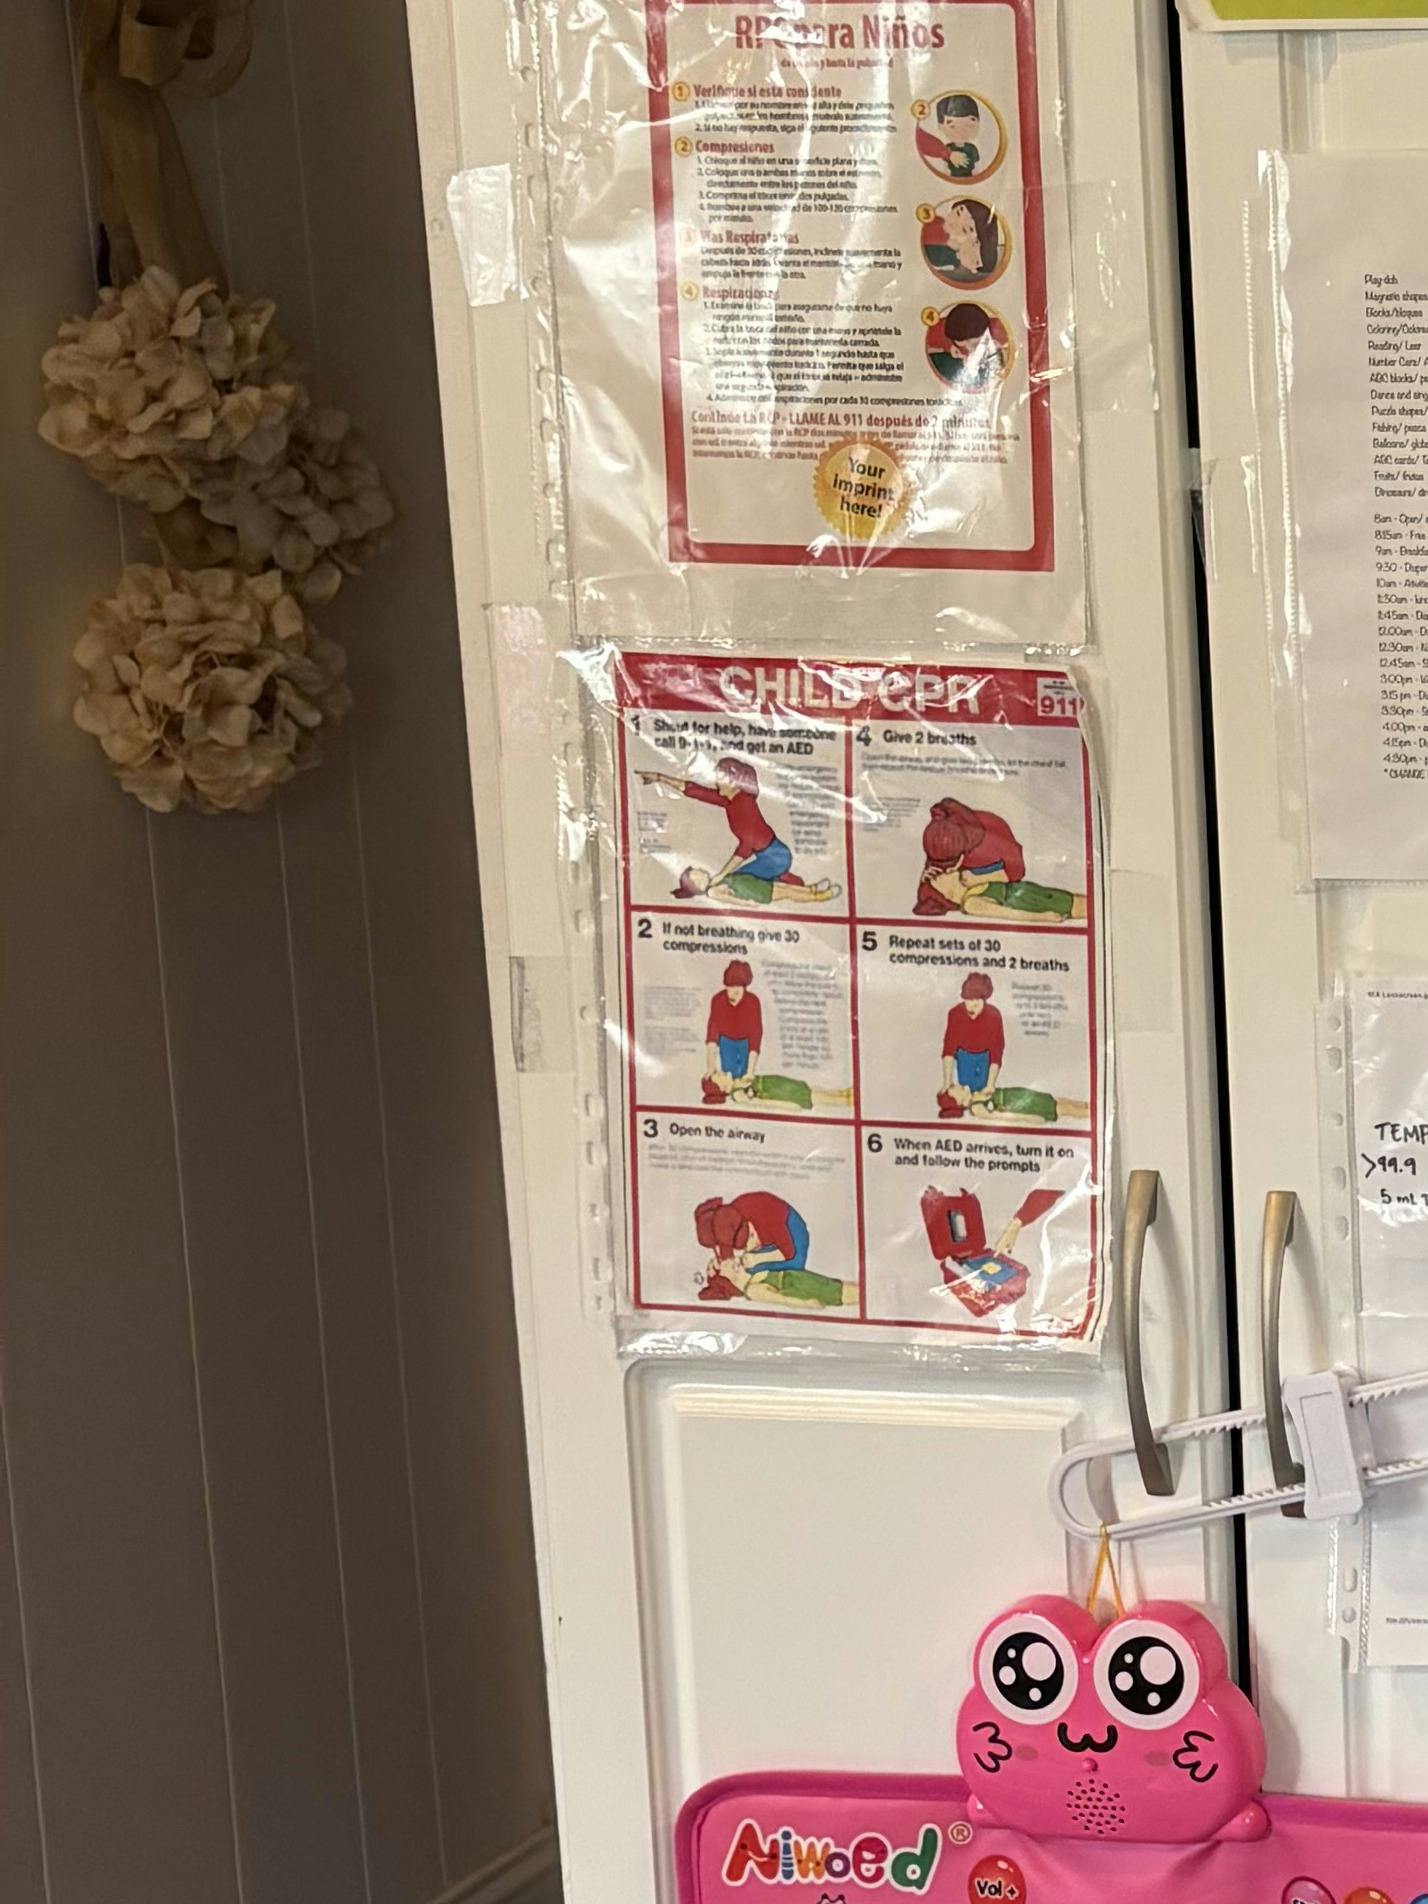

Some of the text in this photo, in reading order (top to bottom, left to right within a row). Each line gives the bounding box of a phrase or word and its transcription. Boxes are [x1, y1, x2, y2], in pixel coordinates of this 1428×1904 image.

[863, 14, 945, 49] Niños
[789, 412, 863, 426] LLAME 911
[849, 457, 886, 480] Your
[833, 474, 894, 502] imprint
[840, 495, 883, 519] here!
[719, 665, 981, 715] CHILD CPR
[1039, 695, 1080, 717] 911
[856, 724, 873, 747] 4
[883, 729, 913, 744] Give
[914, 731, 925, 744] 2
[637, 918, 801, 945] 2 If not breathing give 30
[861, 931, 1002, 953] 5 Repeat sets of 30
[662, 940, 749, 955] compressions
[889, 952, 1070, 973] compressions and 2 breaths
[643, 1118, 766, 1144] 3 Open the airway
[866, 1133, 1075, 1159] 6 When AED arrives, turn it on
[894, 1154, 1042, 1174] and follow the prompts
[1380, 1188, 1392, 1204] 5
[722, 1818, 942, 1895] Niwoed
[976, 1880, 1002, 1897] Vol
